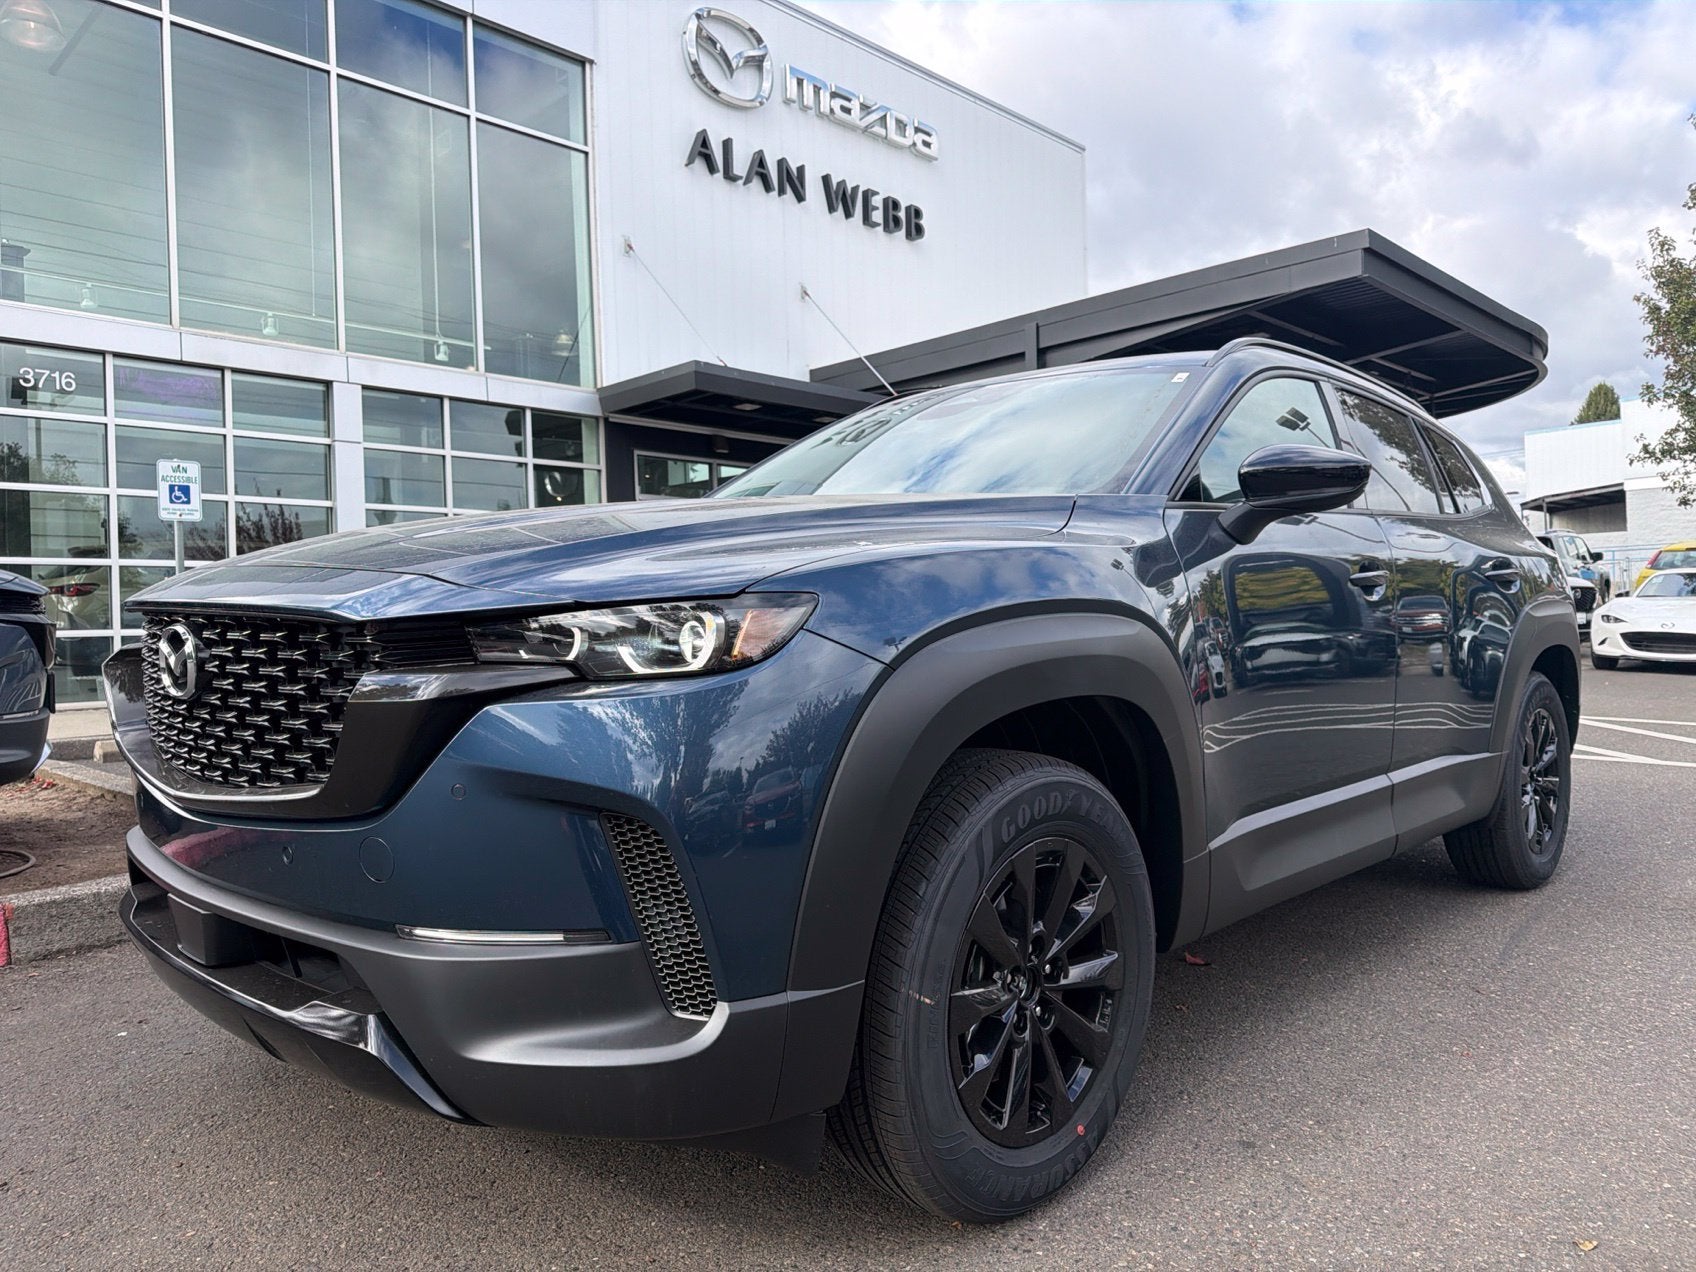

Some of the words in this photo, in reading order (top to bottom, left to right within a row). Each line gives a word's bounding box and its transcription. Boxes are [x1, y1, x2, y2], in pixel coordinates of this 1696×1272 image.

[783, 63, 939, 161] mazda
[684, 128, 806, 204] ALAN
[821, 173, 925, 241] WEBB
[19, 367, 76, 391] 3716
[161, 474, 198, 485] ACCESSIBLE
[171, 464, 188, 474] VAN
